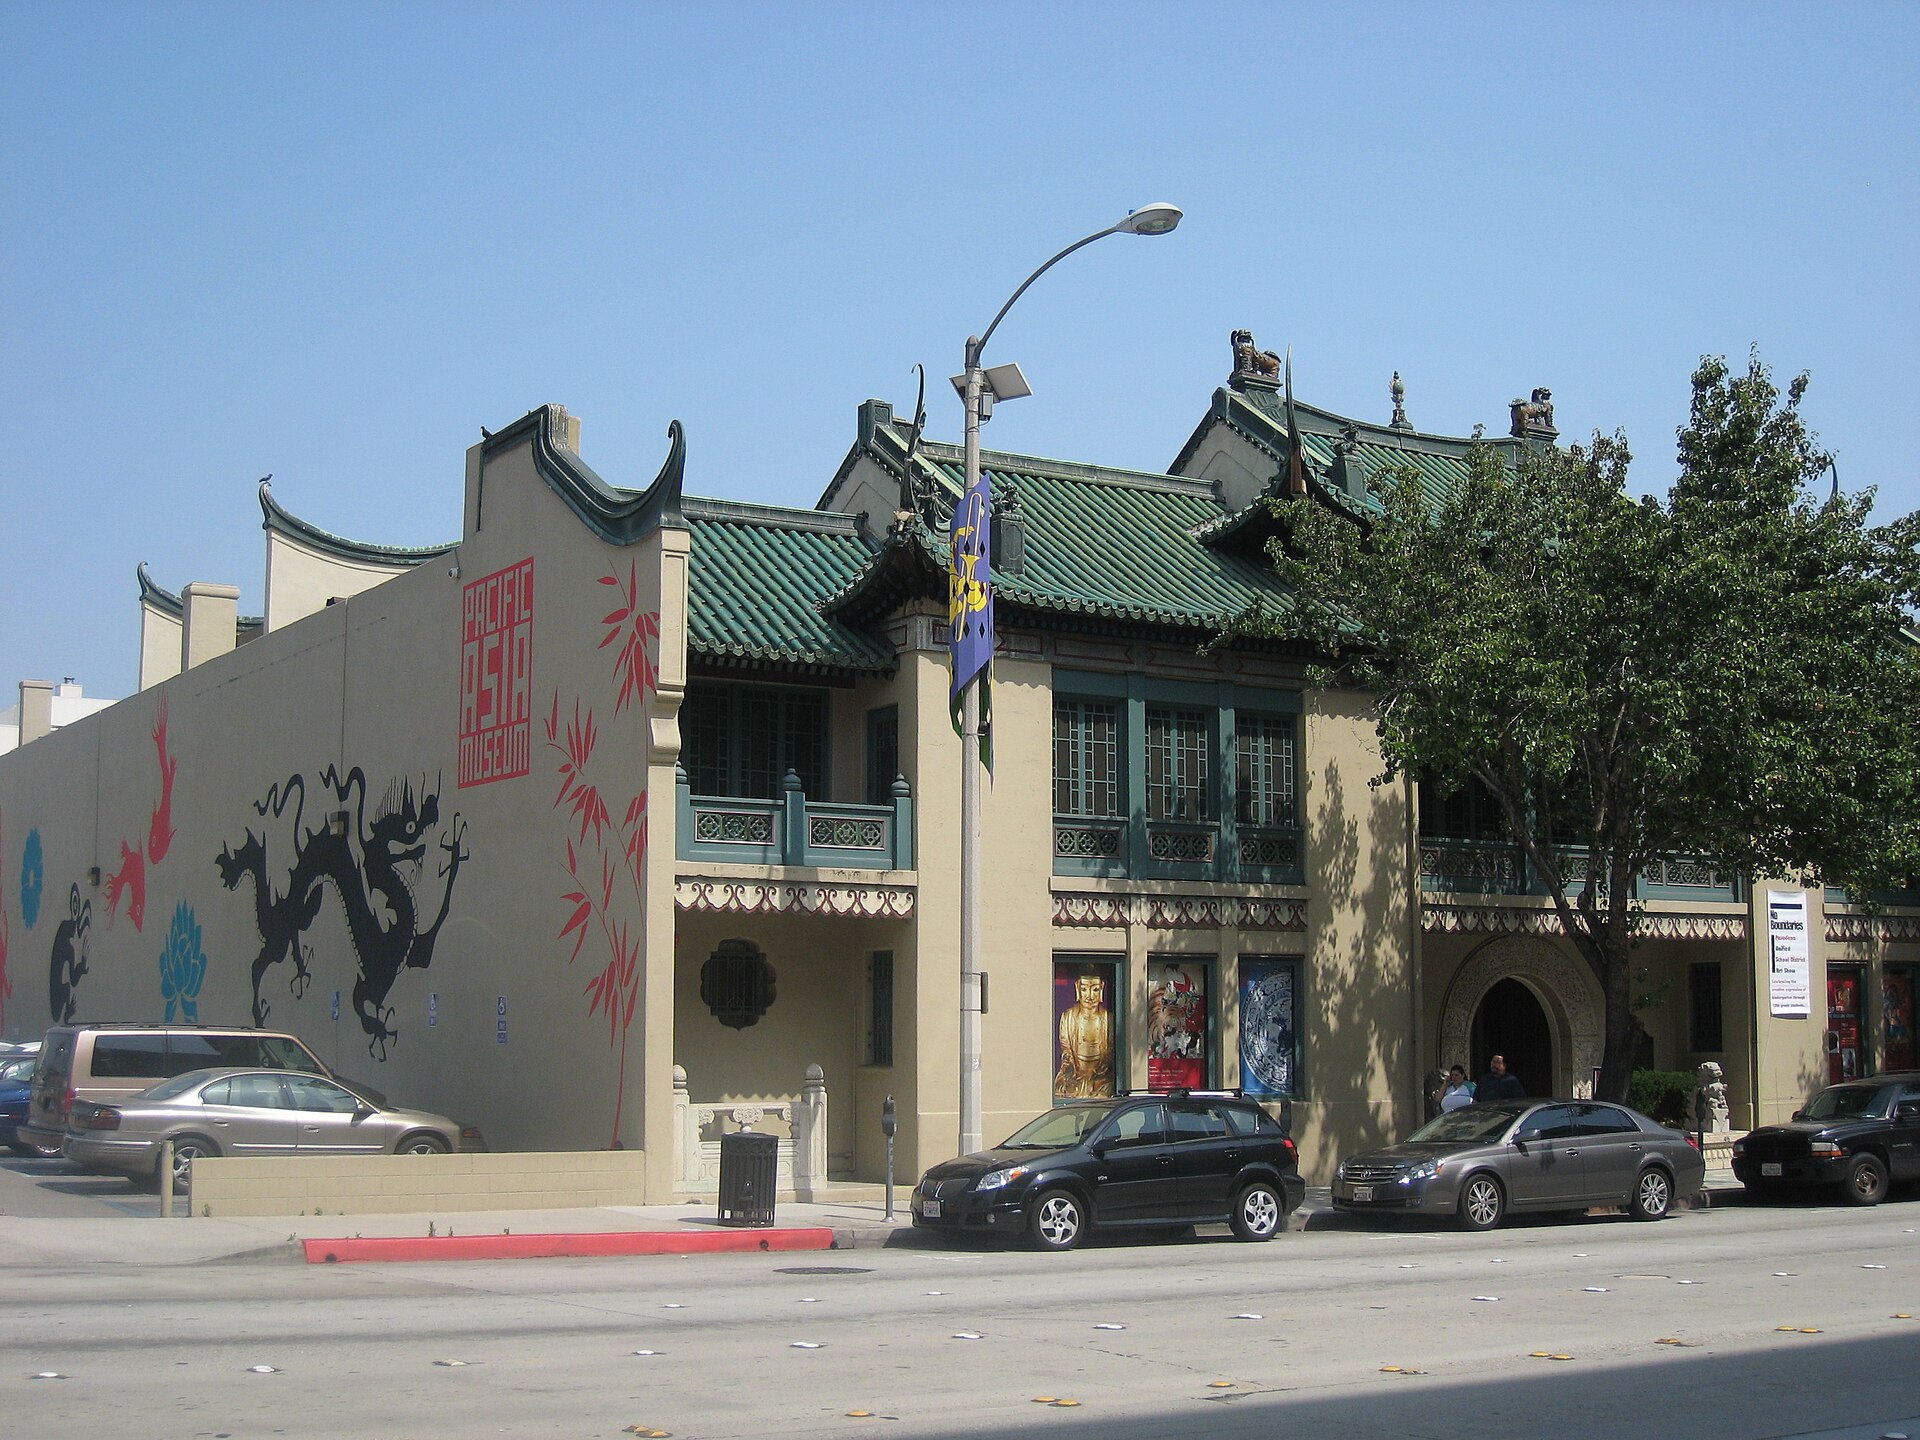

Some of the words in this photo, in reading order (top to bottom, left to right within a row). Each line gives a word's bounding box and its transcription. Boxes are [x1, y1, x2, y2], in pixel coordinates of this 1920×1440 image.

[464, 562, 532, 641] PACIFIC
[461, 620, 531, 734] ASIA
[459, 723, 528, 785] MUSEUM
[1770, 910, 1778, 919] No
[1770, 920, 1804, 930] Boundaries
